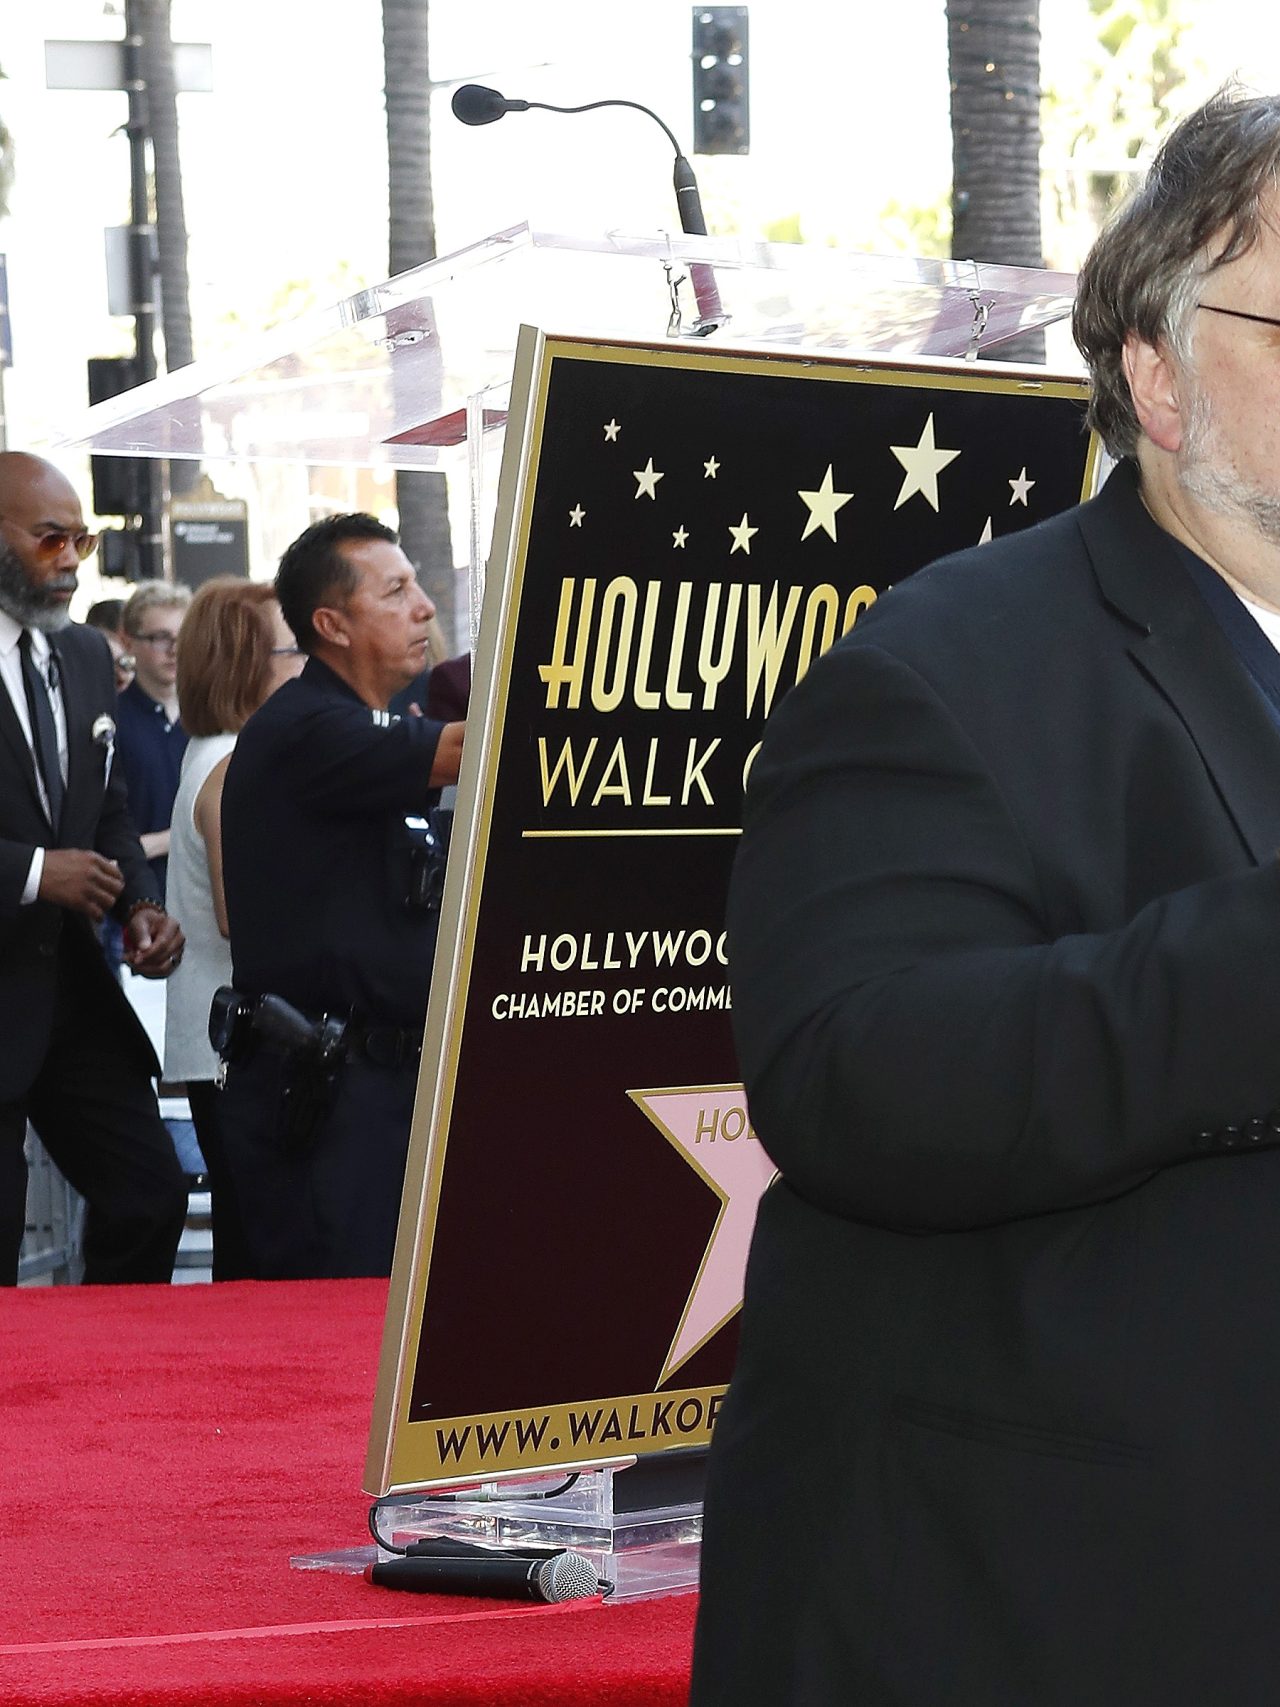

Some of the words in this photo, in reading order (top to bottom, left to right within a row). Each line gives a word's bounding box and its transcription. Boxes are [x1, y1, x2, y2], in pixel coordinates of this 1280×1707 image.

[538, 736, 722, 807] WALK
[491, 989, 605, 1020] CHAMBER
[612, 988, 646, 1013] OF
